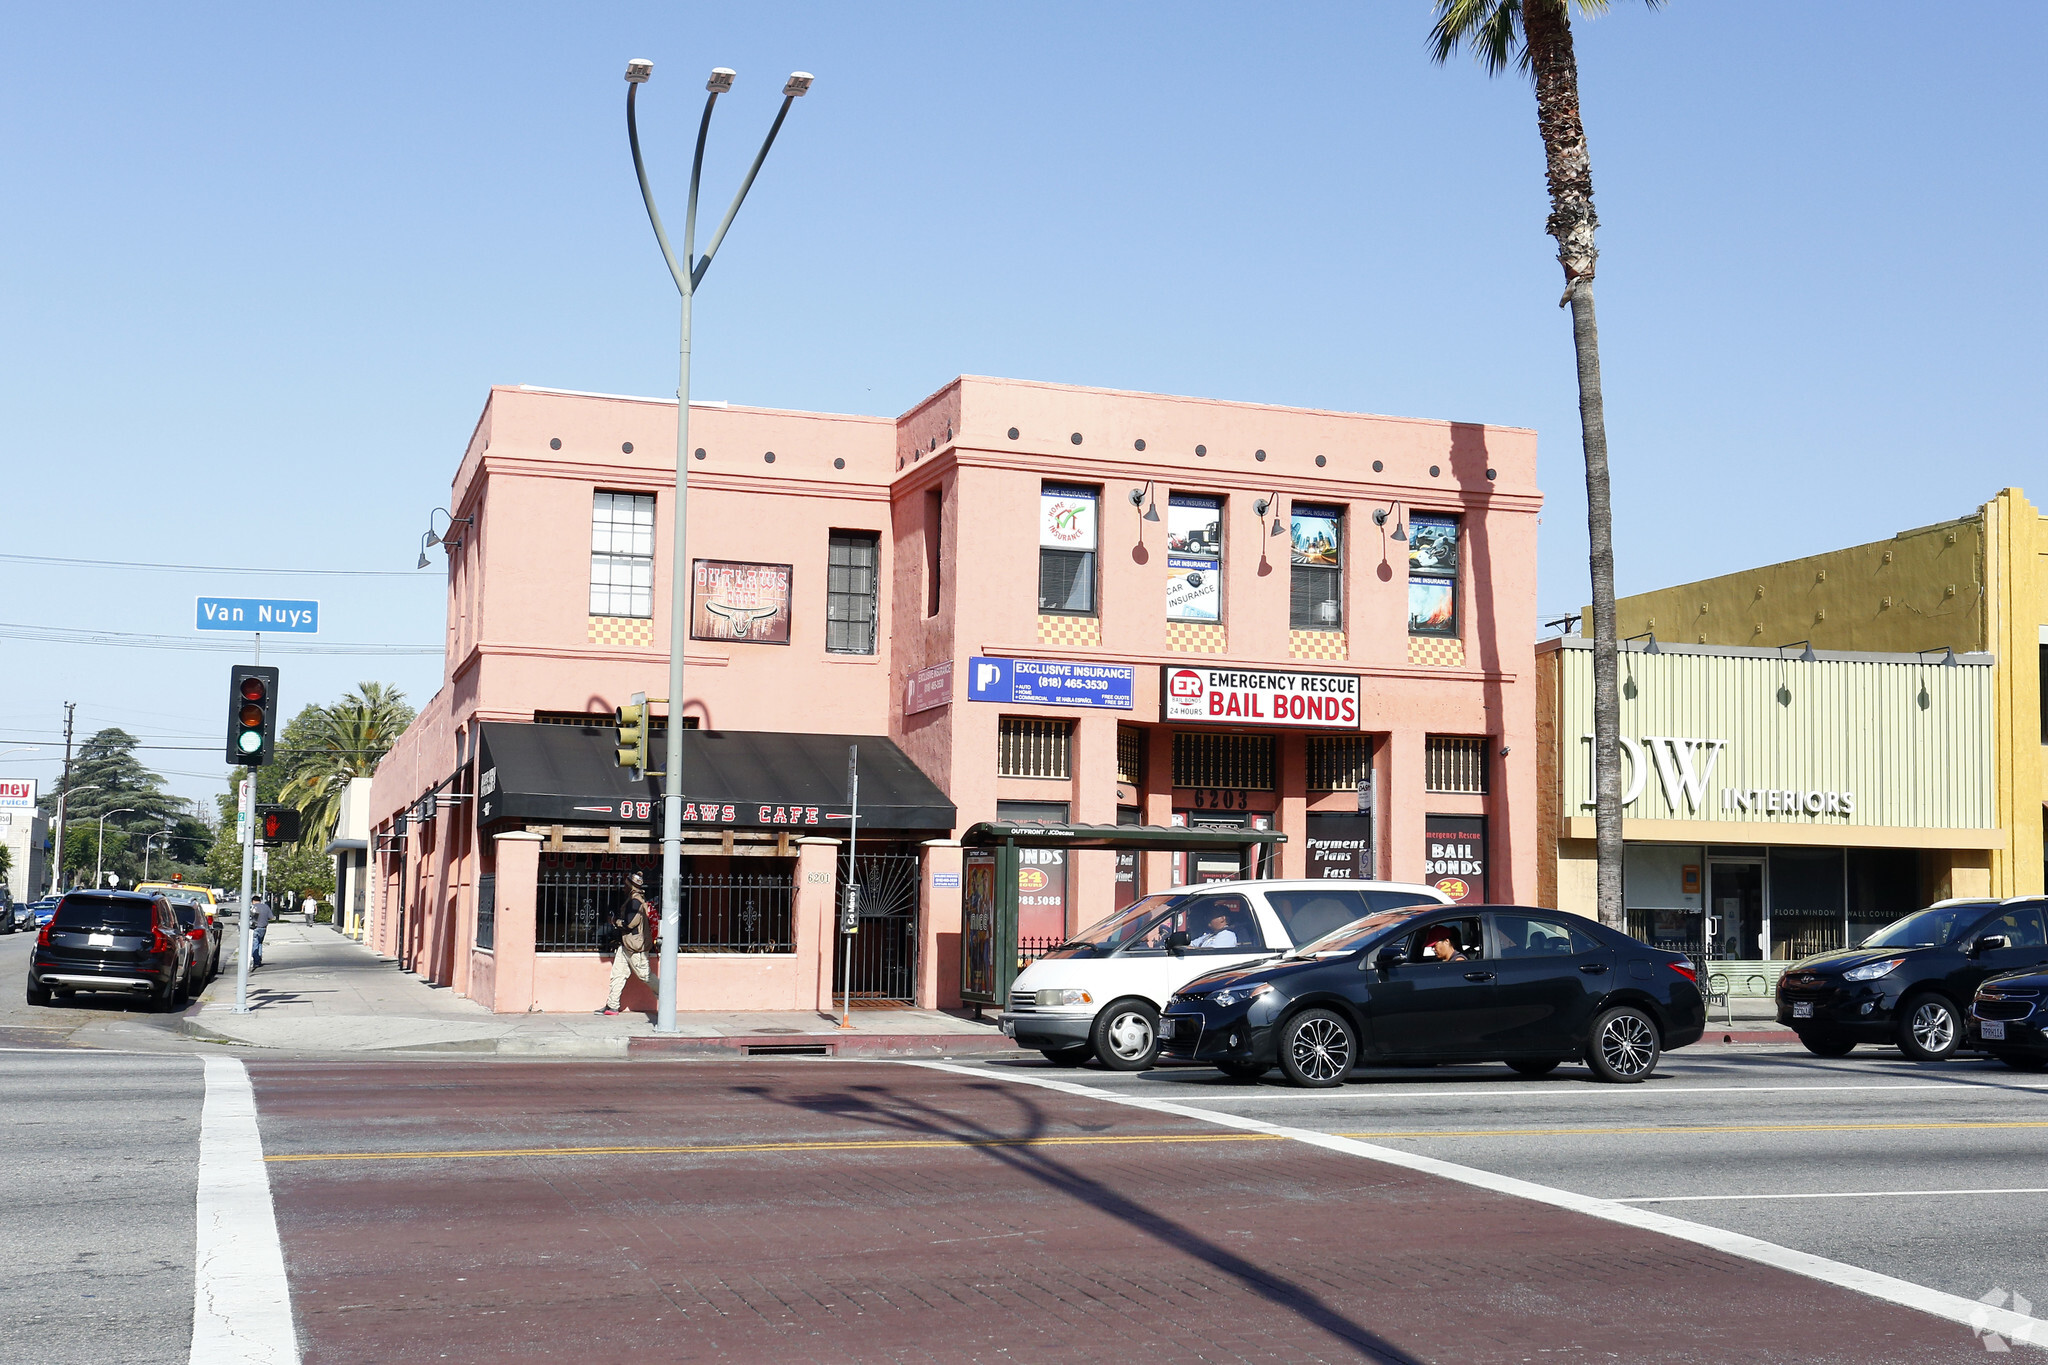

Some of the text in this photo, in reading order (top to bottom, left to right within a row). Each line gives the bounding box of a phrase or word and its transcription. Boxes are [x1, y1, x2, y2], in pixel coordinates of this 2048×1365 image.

[1043, 488, 1092, 499] HOME INSURANCE
[1048, 501, 1065, 517] HOME
[1186, 500, 1217, 508] INSURANCE
[1049, 525, 1084, 541] INSURANCE
[1182, 561, 1212, 569] INSURANCE
[697, 567, 787, 592] OUTLAWS
[1422, 578, 1451, 586] INSURANCE
[1167, 583, 1183, 596] CAR
[1169, 584, 1215, 608] INSURANCE
[204, 603, 313, 628] Van Nuys
[1015, 663, 1131, 680] EXCLUSIVE INSURANCE
[1038, 676, 1109, 690] (818) 465-3530
[1173, 676, 1202, 696] ER
[1209, 672, 1355, 694] EMERGENCY RESCUE
[1170, 707, 1203, 716] 24 HOURS
[1209, 691, 1355, 722] BAIL BONDS
[1195, 789, 1247, 809] 6203
[1721, 788, 1856, 813] INTERIORS
[620, 801, 820, 825] OUAWS CAFE
[1306, 838, 1366, 850] Payment
[1431, 843, 1474, 859] BAIL
[1314, 850, 1352, 861] Plans
[1323, 866, 1352, 878] Fast
[1425, 860, 1483, 876] BONDS
[808, 872, 831, 884] 6201
[1019, 871, 1042, 883] 24
[1440, 881, 1464, 893] 24
[847, 891, 856, 925] Go Metro
[1847, 910, 1866, 918] WALL
